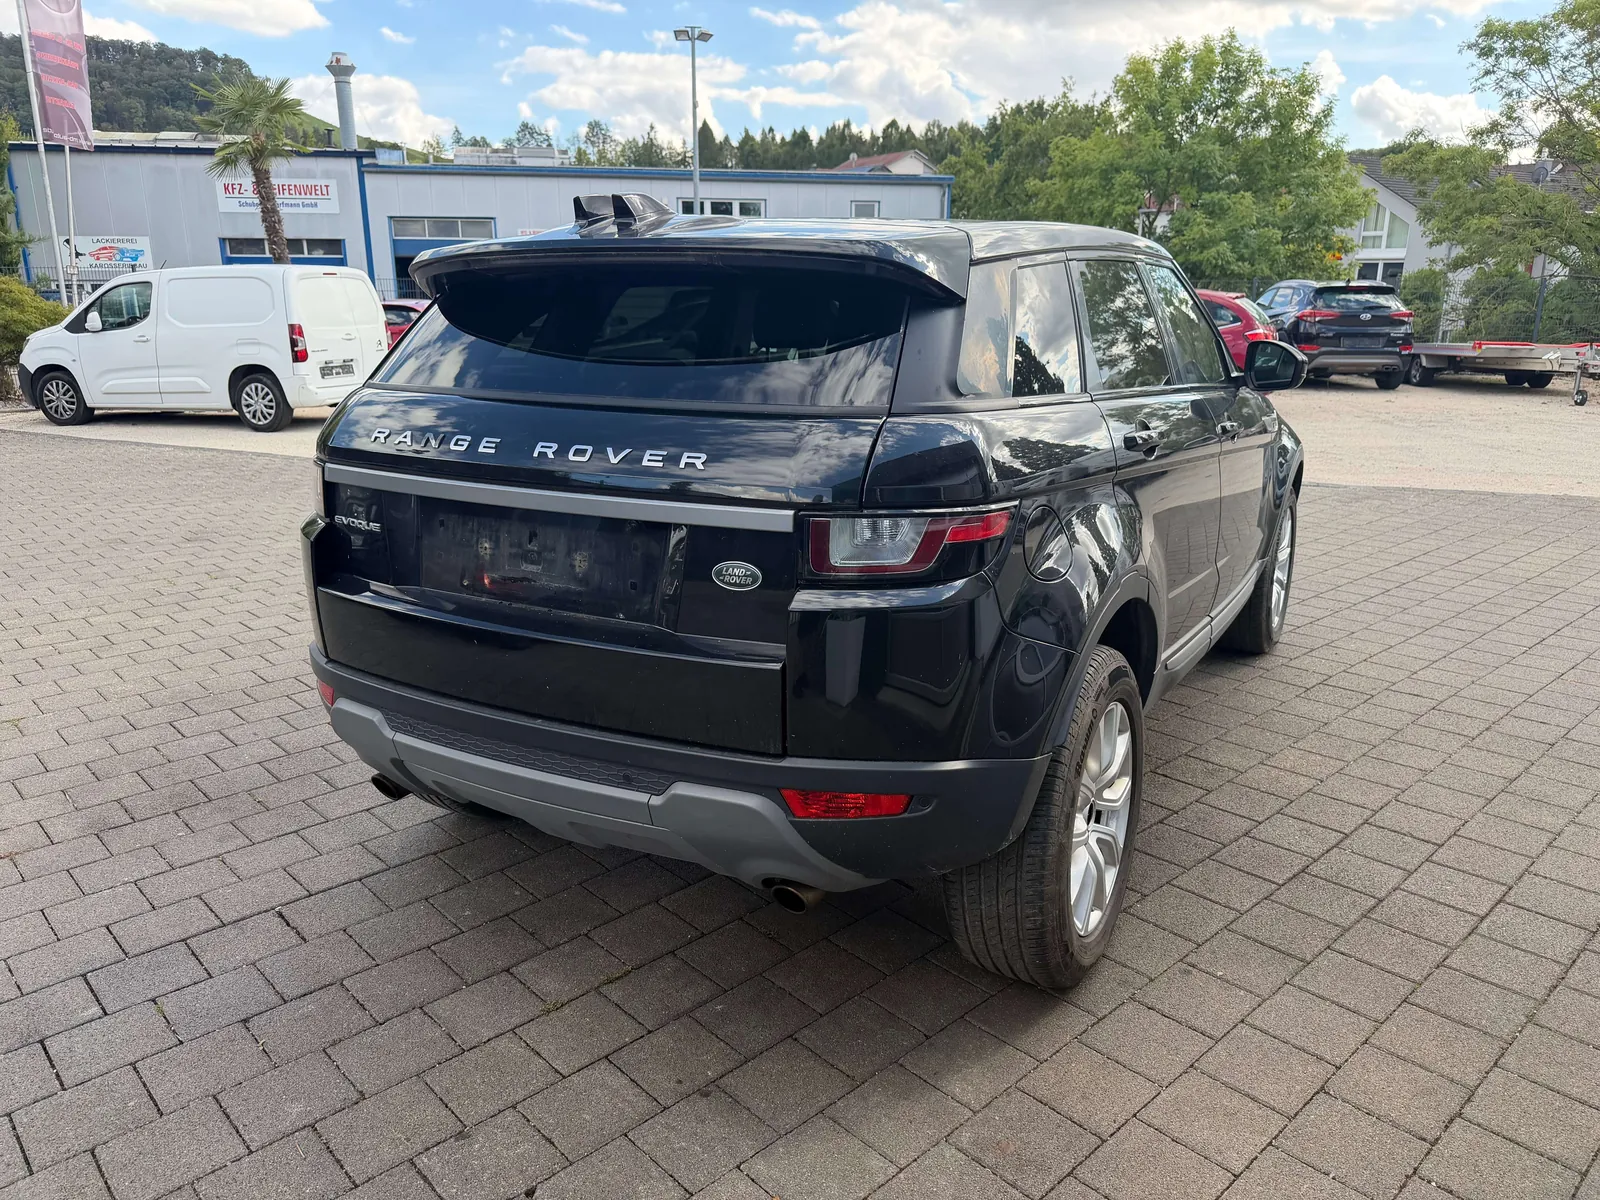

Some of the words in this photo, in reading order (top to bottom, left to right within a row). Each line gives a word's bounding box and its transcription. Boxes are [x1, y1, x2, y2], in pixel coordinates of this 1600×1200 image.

[223, 183, 248, 195] KFZ-
[272, 184, 330, 196] EIFENWELT
[238, 200, 258, 208] Schube
[370, 427, 502, 454] RANGE
[532, 441, 708, 470] ROVER
[334, 515, 381, 532] EVOQUE
[722, 567, 746, 576] LAND
[723, 575, 753, 585] ROVER
